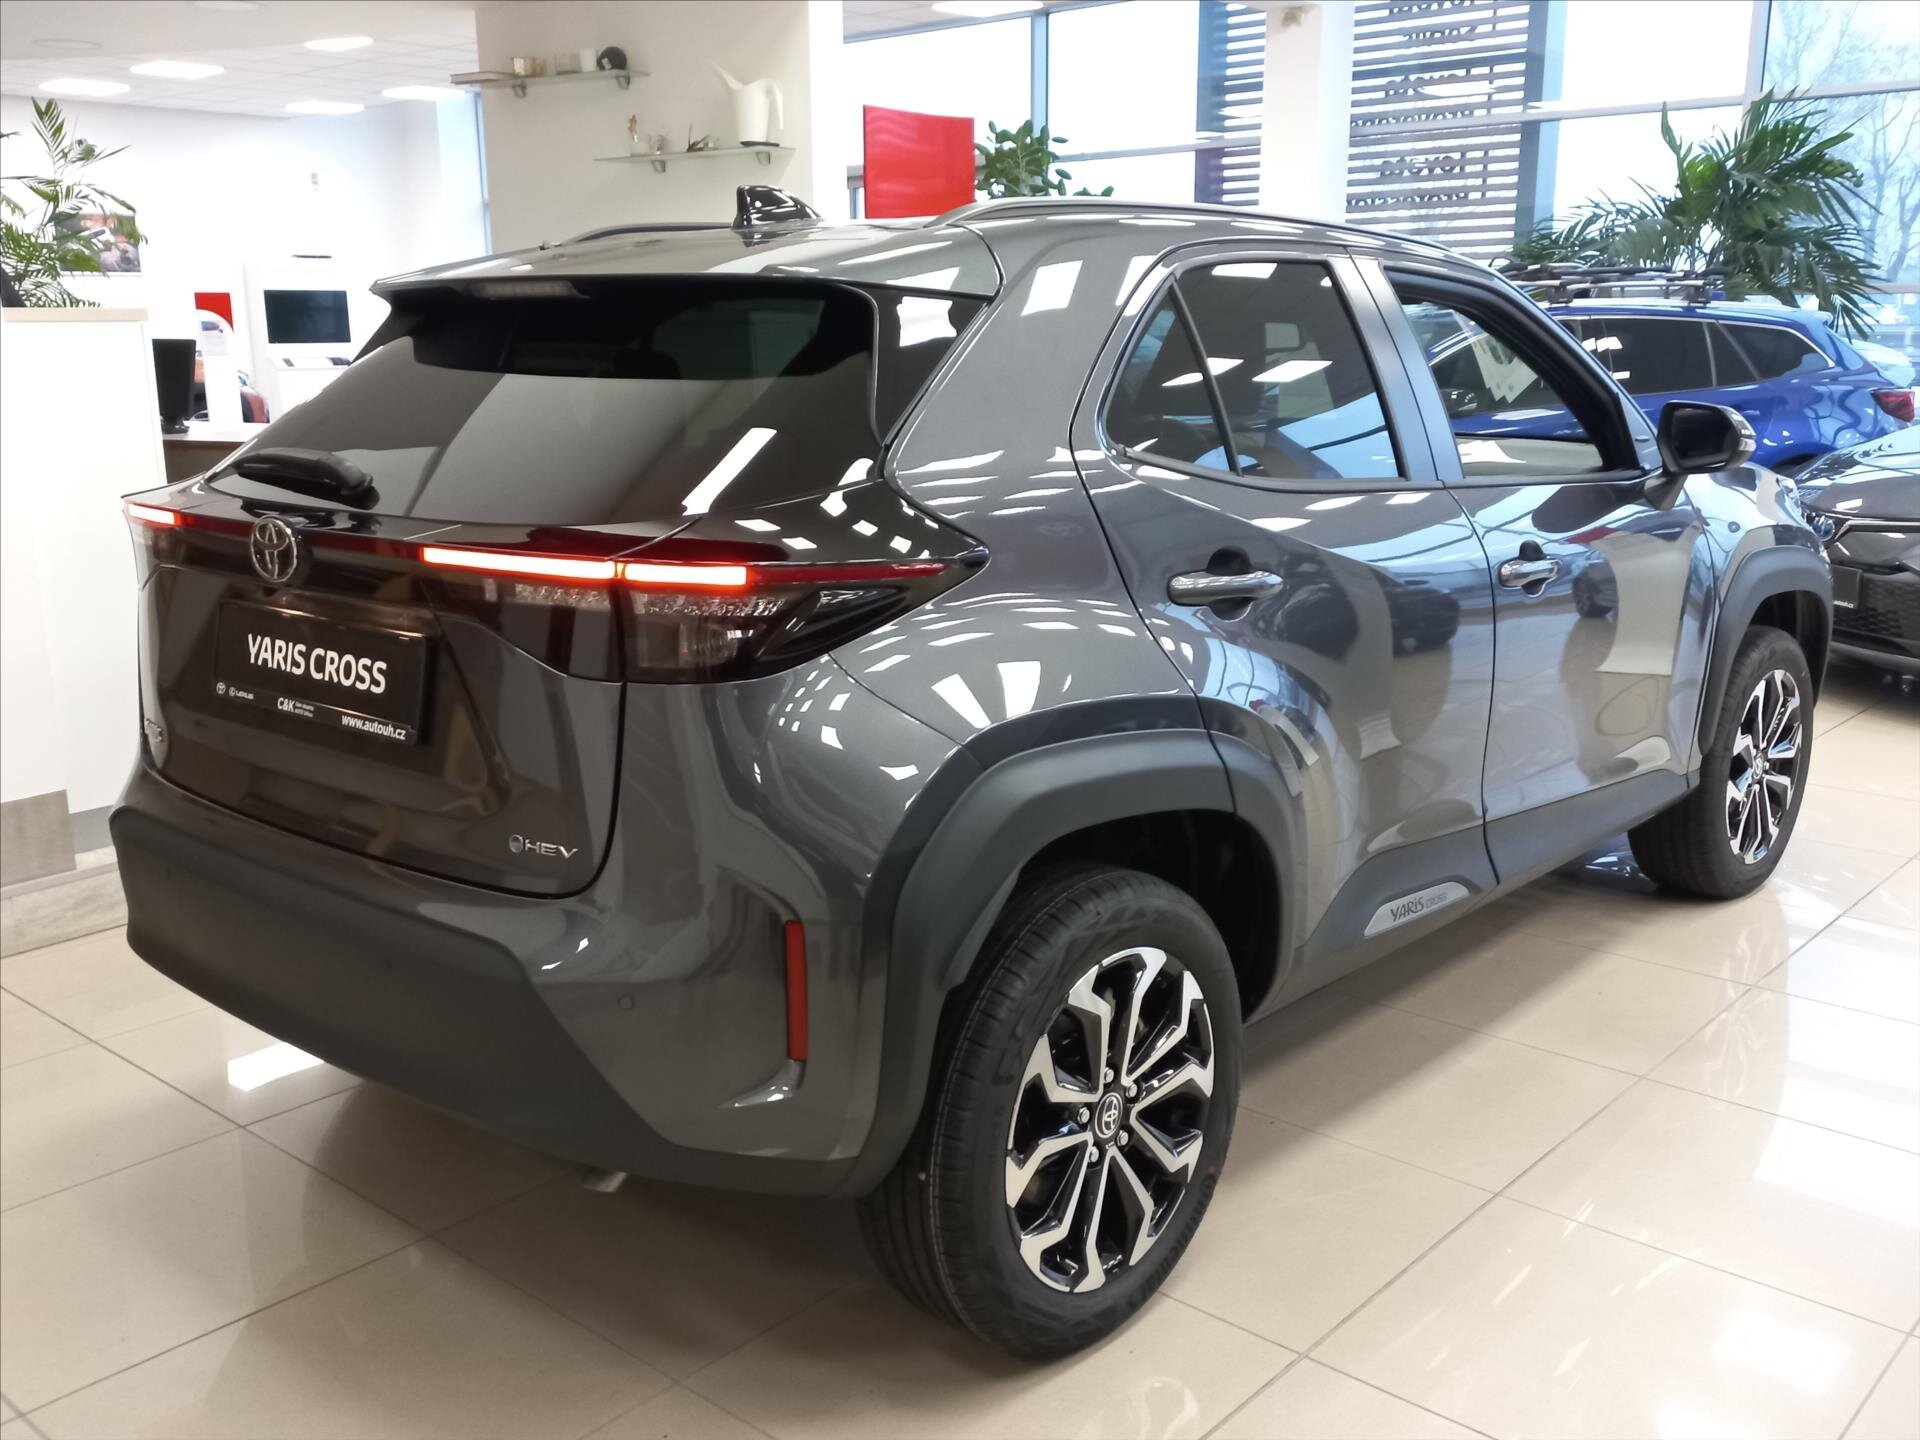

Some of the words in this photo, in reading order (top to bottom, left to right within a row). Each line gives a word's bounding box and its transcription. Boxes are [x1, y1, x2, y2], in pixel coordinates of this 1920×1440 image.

[247, 633, 306, 675] YARIS
[309, 648, 387, 694] CROSS
[277, 697, 295, 712] C&K
[341, 715, 406, 740] www.autouh.cz
[525, 839, 578, 858] HEV
